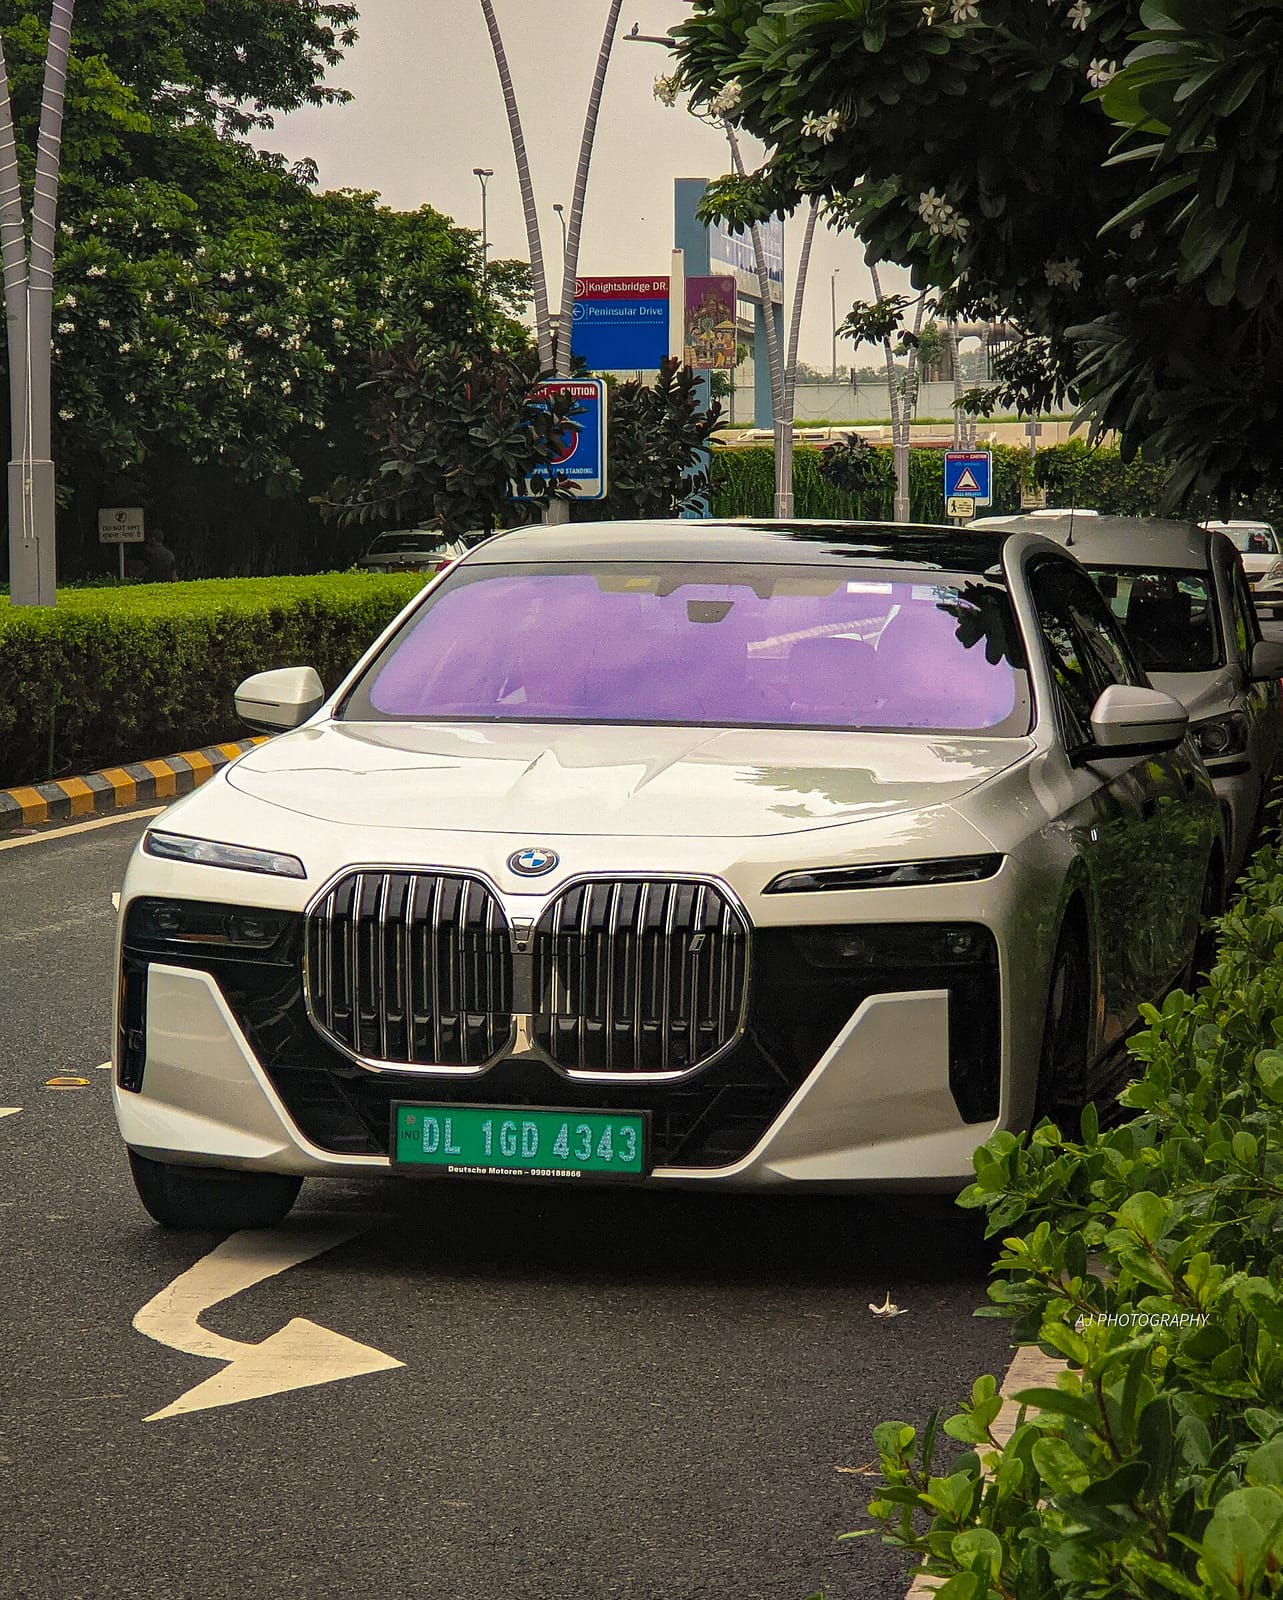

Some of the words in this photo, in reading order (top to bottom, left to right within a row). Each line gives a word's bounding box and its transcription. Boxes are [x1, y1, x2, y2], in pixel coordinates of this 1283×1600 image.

[588, 282, 650, 293] Knightsbridge
[653, 281, 668, 291] DR.
[588, 306, 637, 316] Peninsular
[639, 306, 663, 316] Drive
[560, 387, 595, 396] CUTION
[565, 467, 593, 475] STANDING
[401, 1130, 420, 1140] IND
[422, 1116, 461, 1154] DL
[482, 1119, 539, 1159] 1GD
[552, 1123, 636, 1162] 4343
[447, 1165, 487, 1174] Deutsche
[488, 1167, 523, 1176] Motoren
